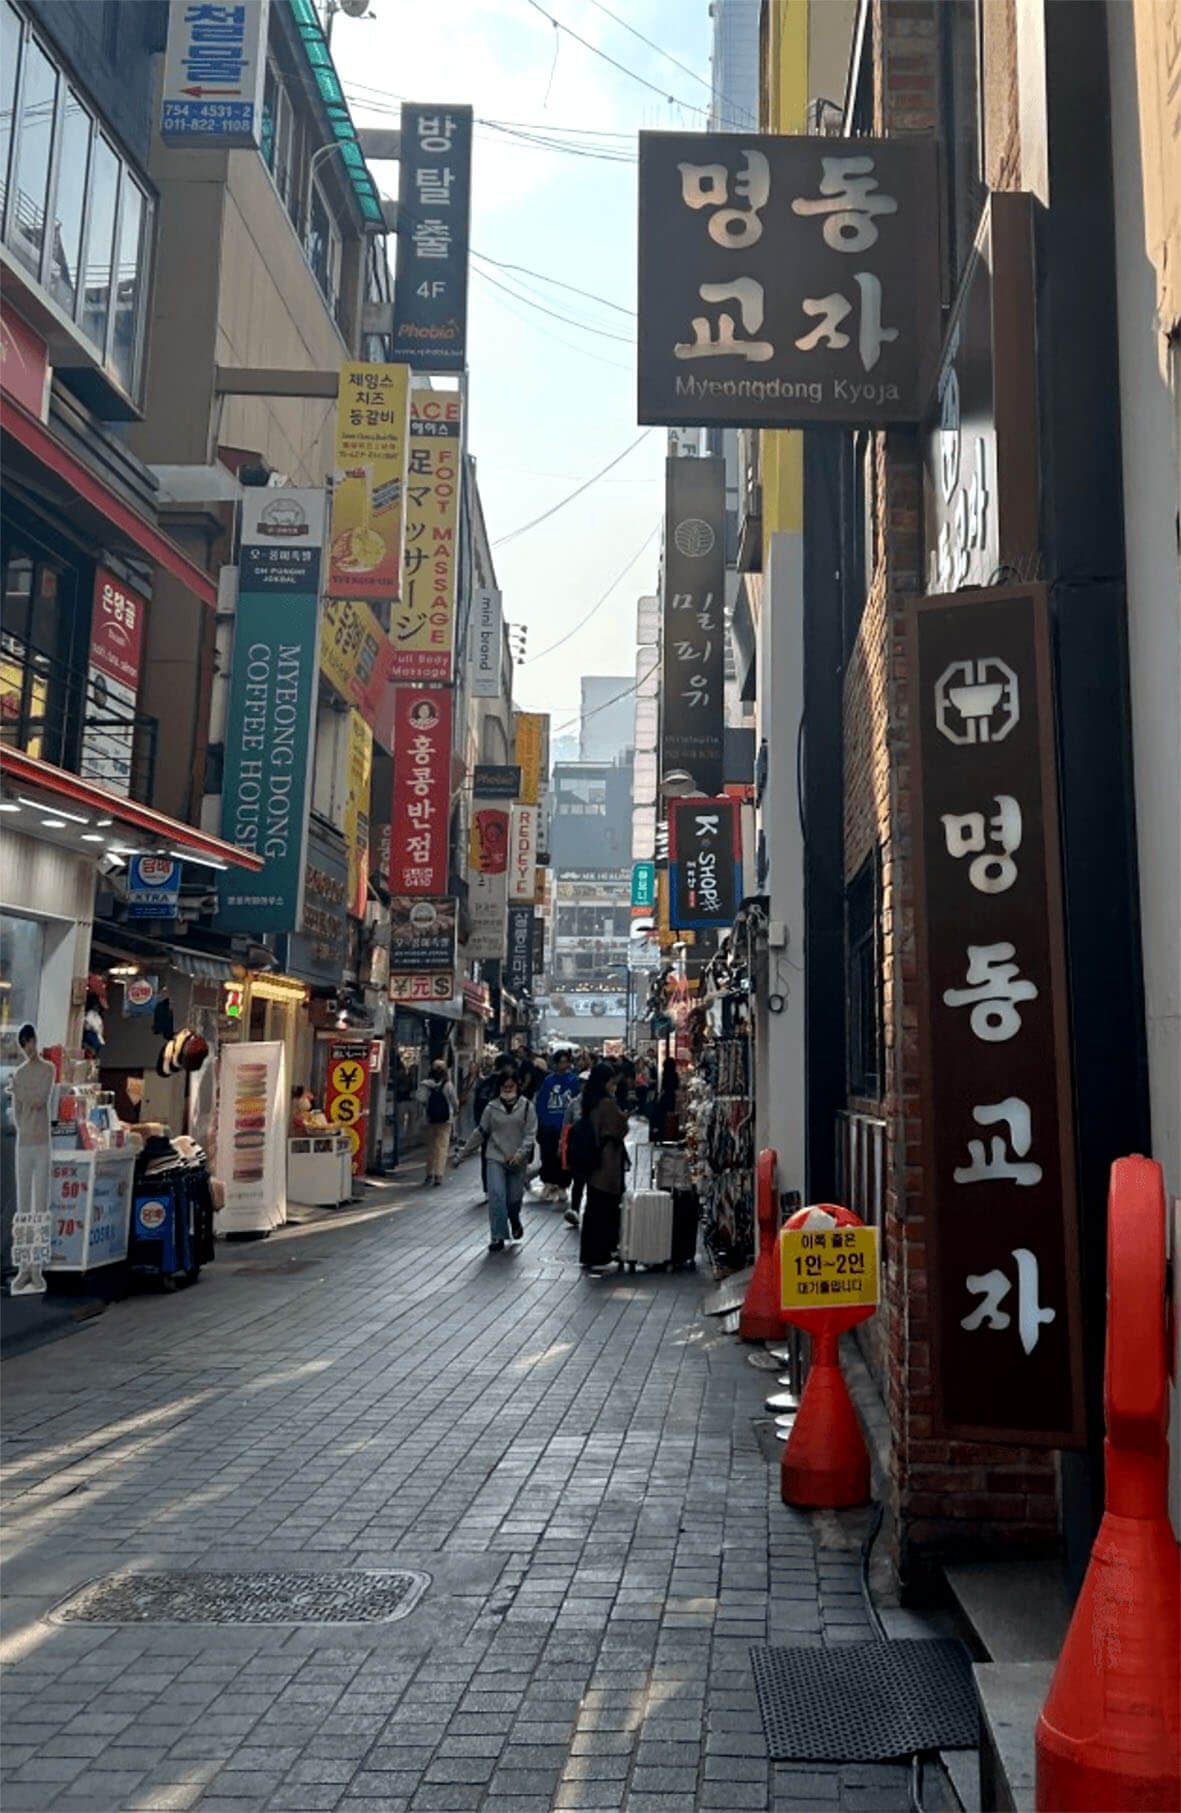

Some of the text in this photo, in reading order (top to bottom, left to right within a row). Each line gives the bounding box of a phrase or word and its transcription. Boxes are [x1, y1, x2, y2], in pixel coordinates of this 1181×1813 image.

[412, 115, 457, 259] 방탈출
[676, 149, 899, 253] 명동
[416, 281, 446, 299] 4F
[673, 271, 900, 373] 교자
[349, 408, 395, 427] 등갈비
[355, 391, 386, 406] 치즈
[410, 402, 459, 420] ACE
[675, 375, 900, 405] Myeongdong Kyoja
[434, 450, 455, 515] FOOT
[428, 526, 453, 644] MASSAGE
[478, 626, 494, 672] brand
[241, 642, 272, 752] COFFEE
[263, 643, 302, 859] MYEONG DONG
[406, 734, 437, 864] 홍콩반점
[516, 811, 532, 894] REDEYE
[939, 794, 1056, 1356] 명동교자
[794, 1252, 865, 1276] 1인~2인
